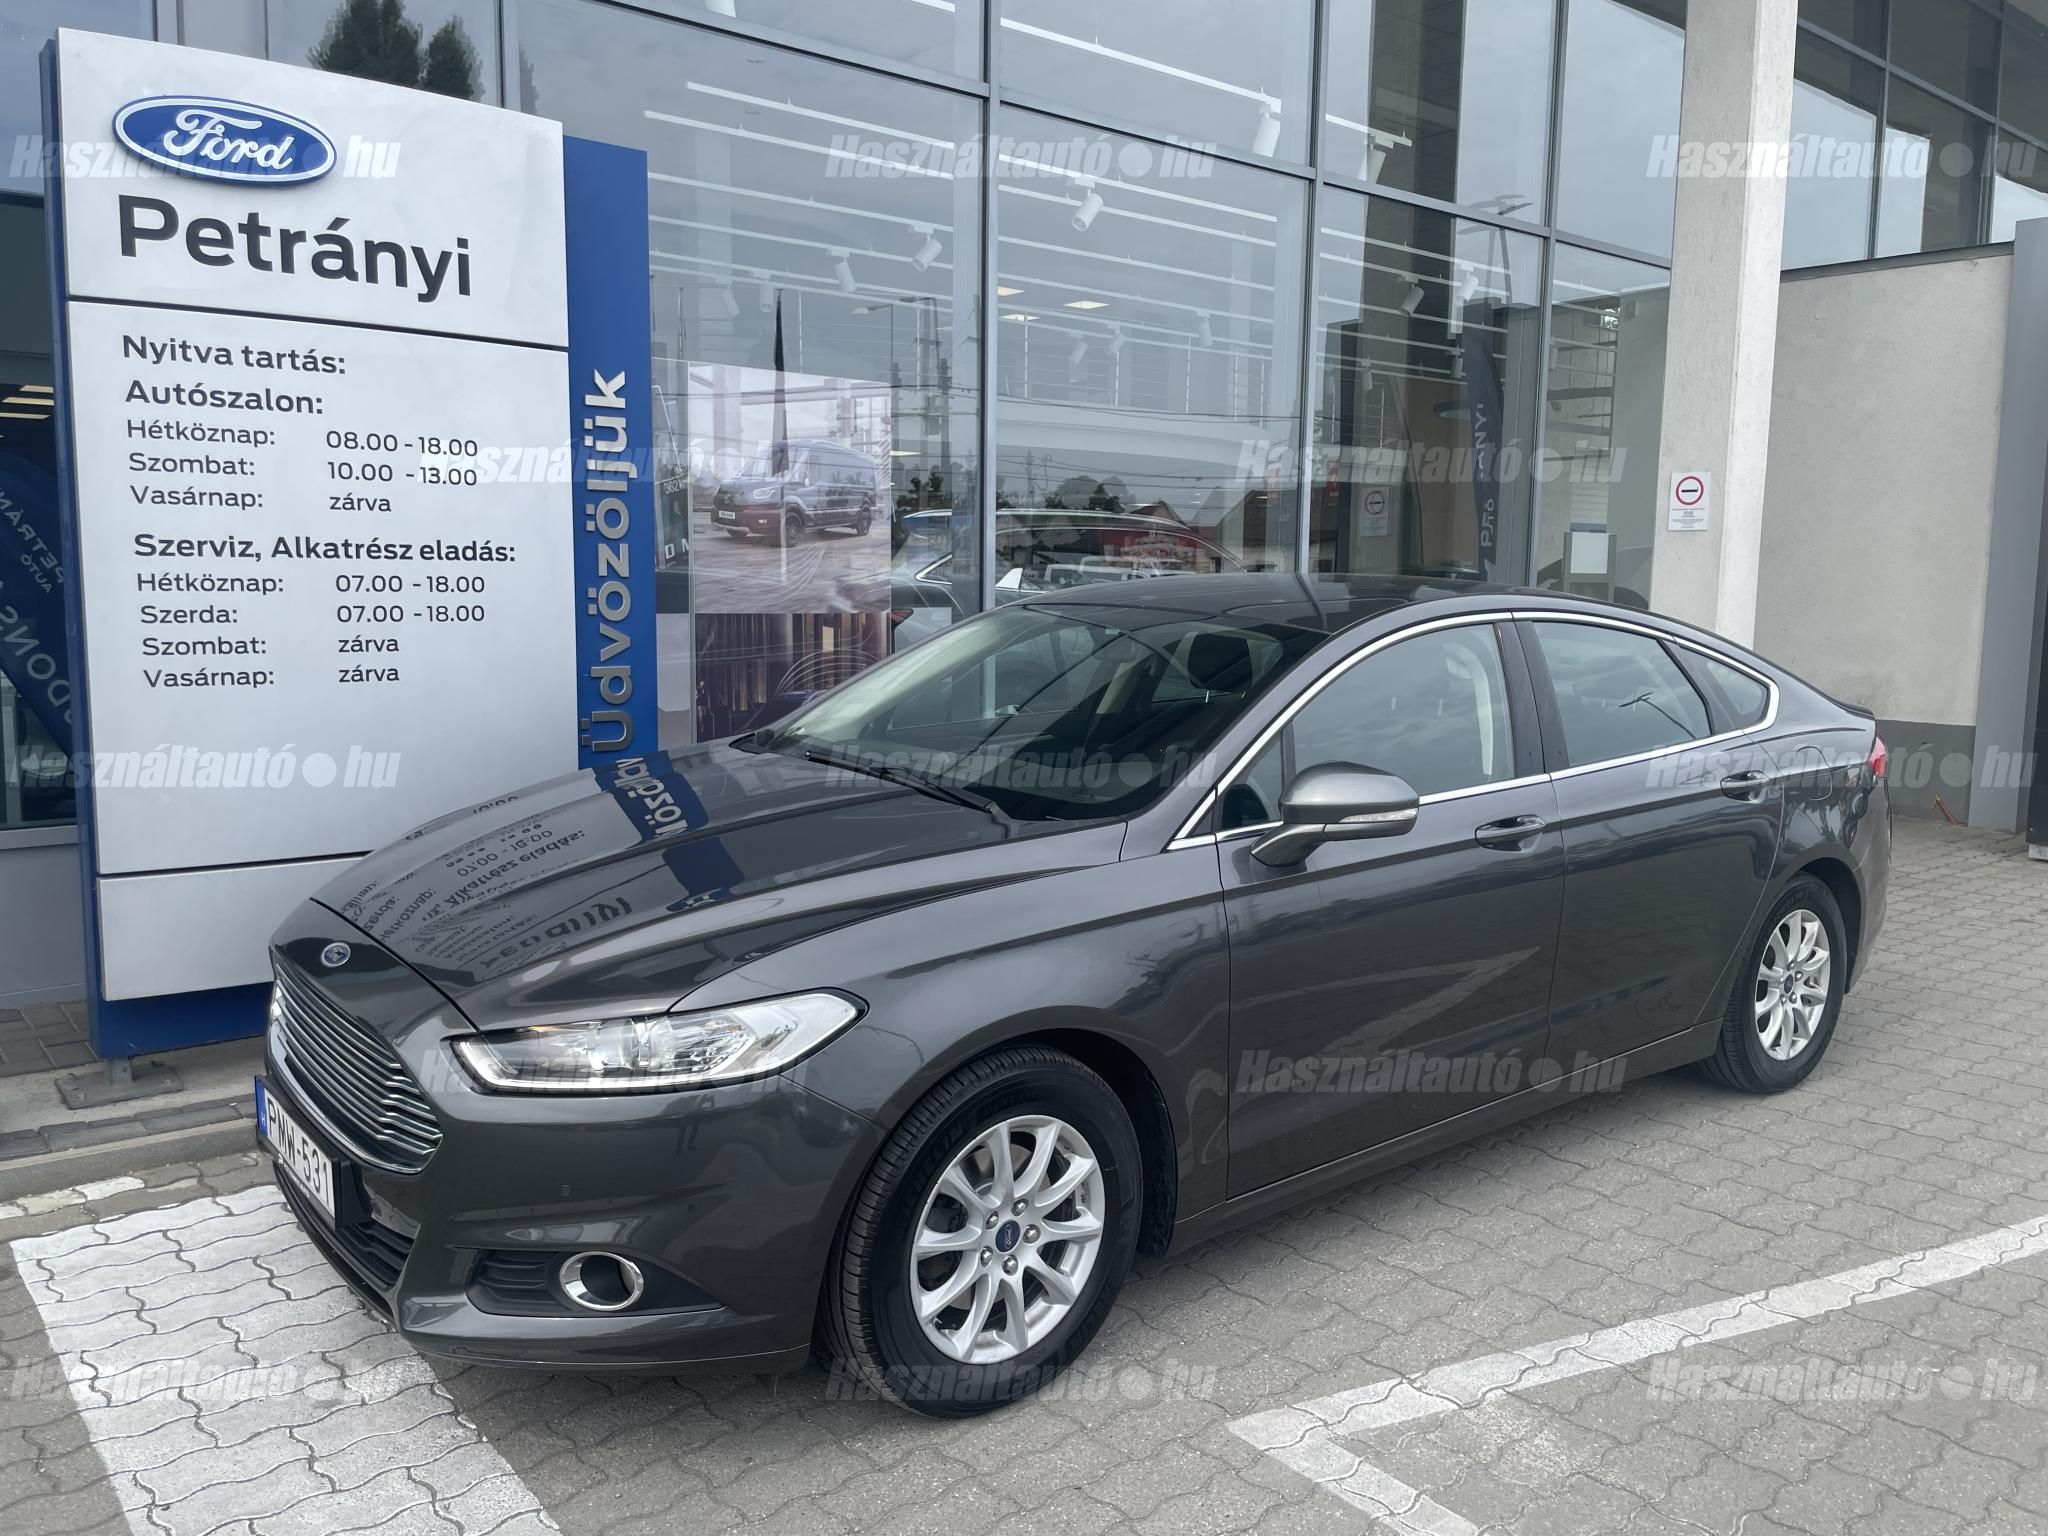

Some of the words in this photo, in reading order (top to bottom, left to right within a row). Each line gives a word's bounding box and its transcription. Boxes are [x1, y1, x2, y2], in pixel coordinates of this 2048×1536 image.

[162, 106, 299, 171] Ford
[117, 194, 472, 303] Petrányi
[122, 334, 234, 366] Nyitva
[240, 345, 346, 375] tartás:
[125, 379, 323, 415] Autószalon:
[127, 419, 275, 448] Hétköznap:
[326, 430, 398, 452] 08.00
[129, 452, 255, 476] Szombat:
[327, 461, 393, 482] 10.00
[129, 485, 263, 511] Vasárnap:
[329, 492, 392, 513] zárva
[134, 533, 262, 563] Szerviz,
[271, 535, 414, 561] Alkatrész
[419, 539, 516, 562] eladás:
[580, 368, 638, 752] Üdvözöljük
[137, 572, 284, 596] Hétköznap:
[335, 574, 403, 593] 07.00
[140, 604, 238, 624] Szerda:
[336, 605, 404, 623] 07.00
[142, 636, 267, 656] Szombat:
[338, 634, 400, 653] zárva
[143, 667, 274, 689] Vasárnap:
[338, 664, 400, 683] zárva
